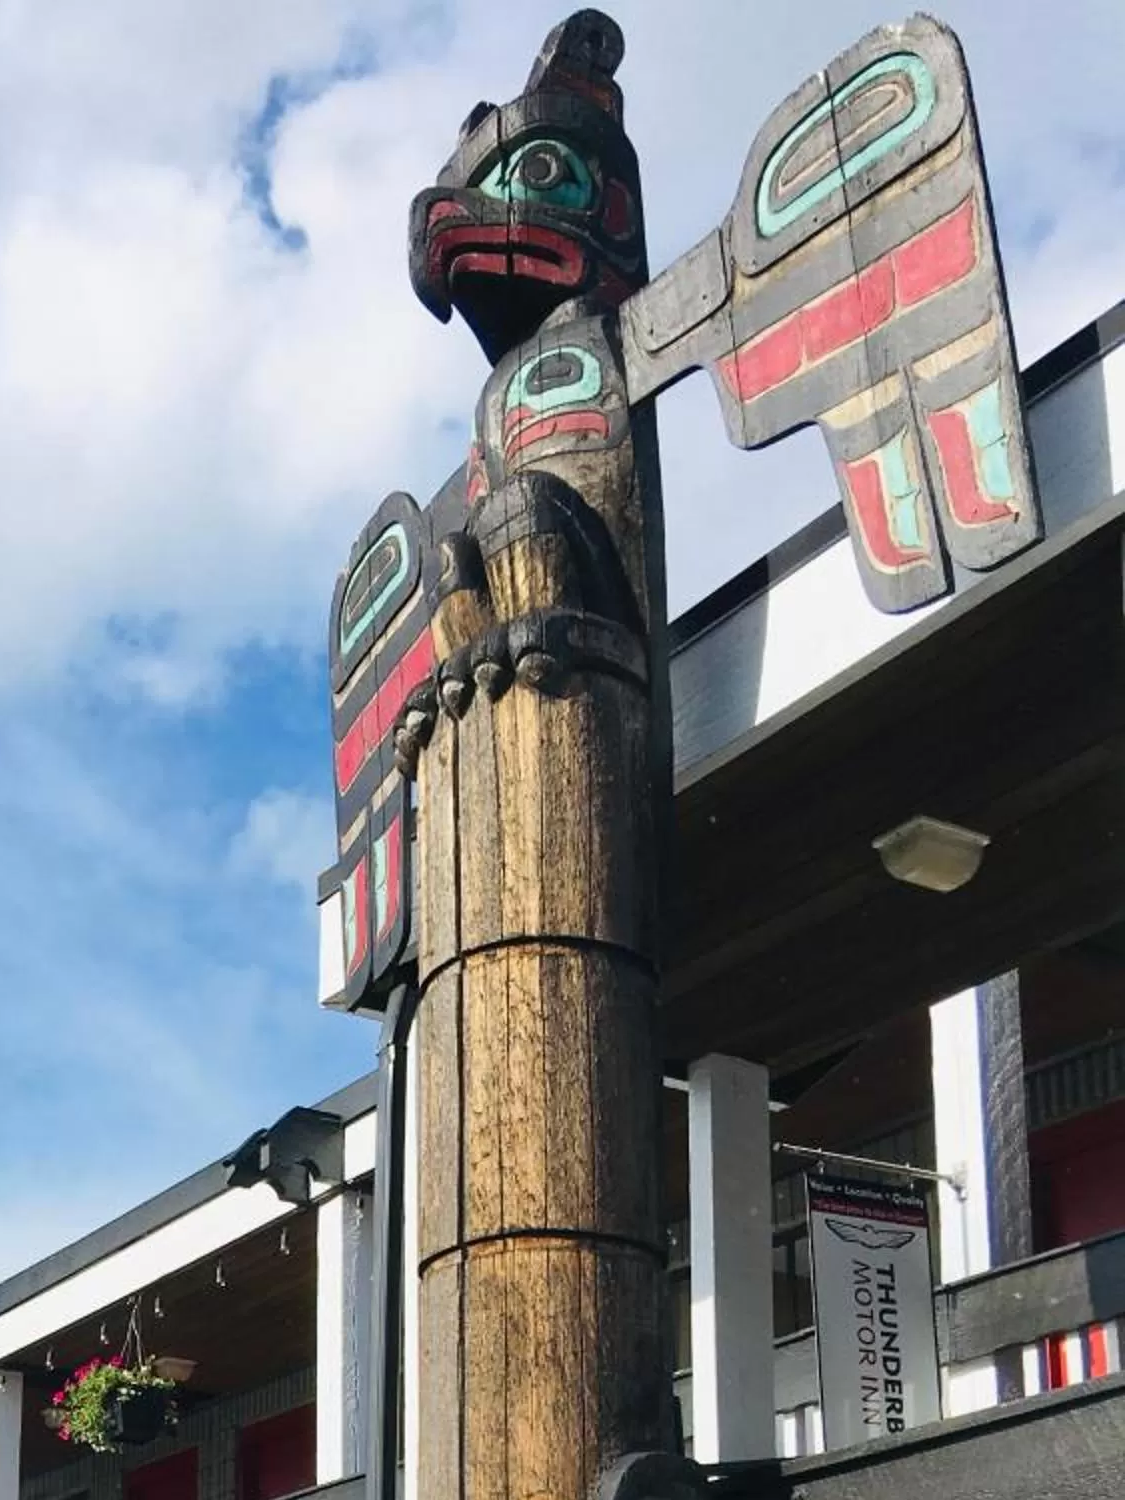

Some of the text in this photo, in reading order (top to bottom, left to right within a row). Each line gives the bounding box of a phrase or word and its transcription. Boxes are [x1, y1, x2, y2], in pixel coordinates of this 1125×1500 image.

[852, 1260, 882, 1426] MOTOR INN
[876, 1264, 905, 1433] THUNDERB
